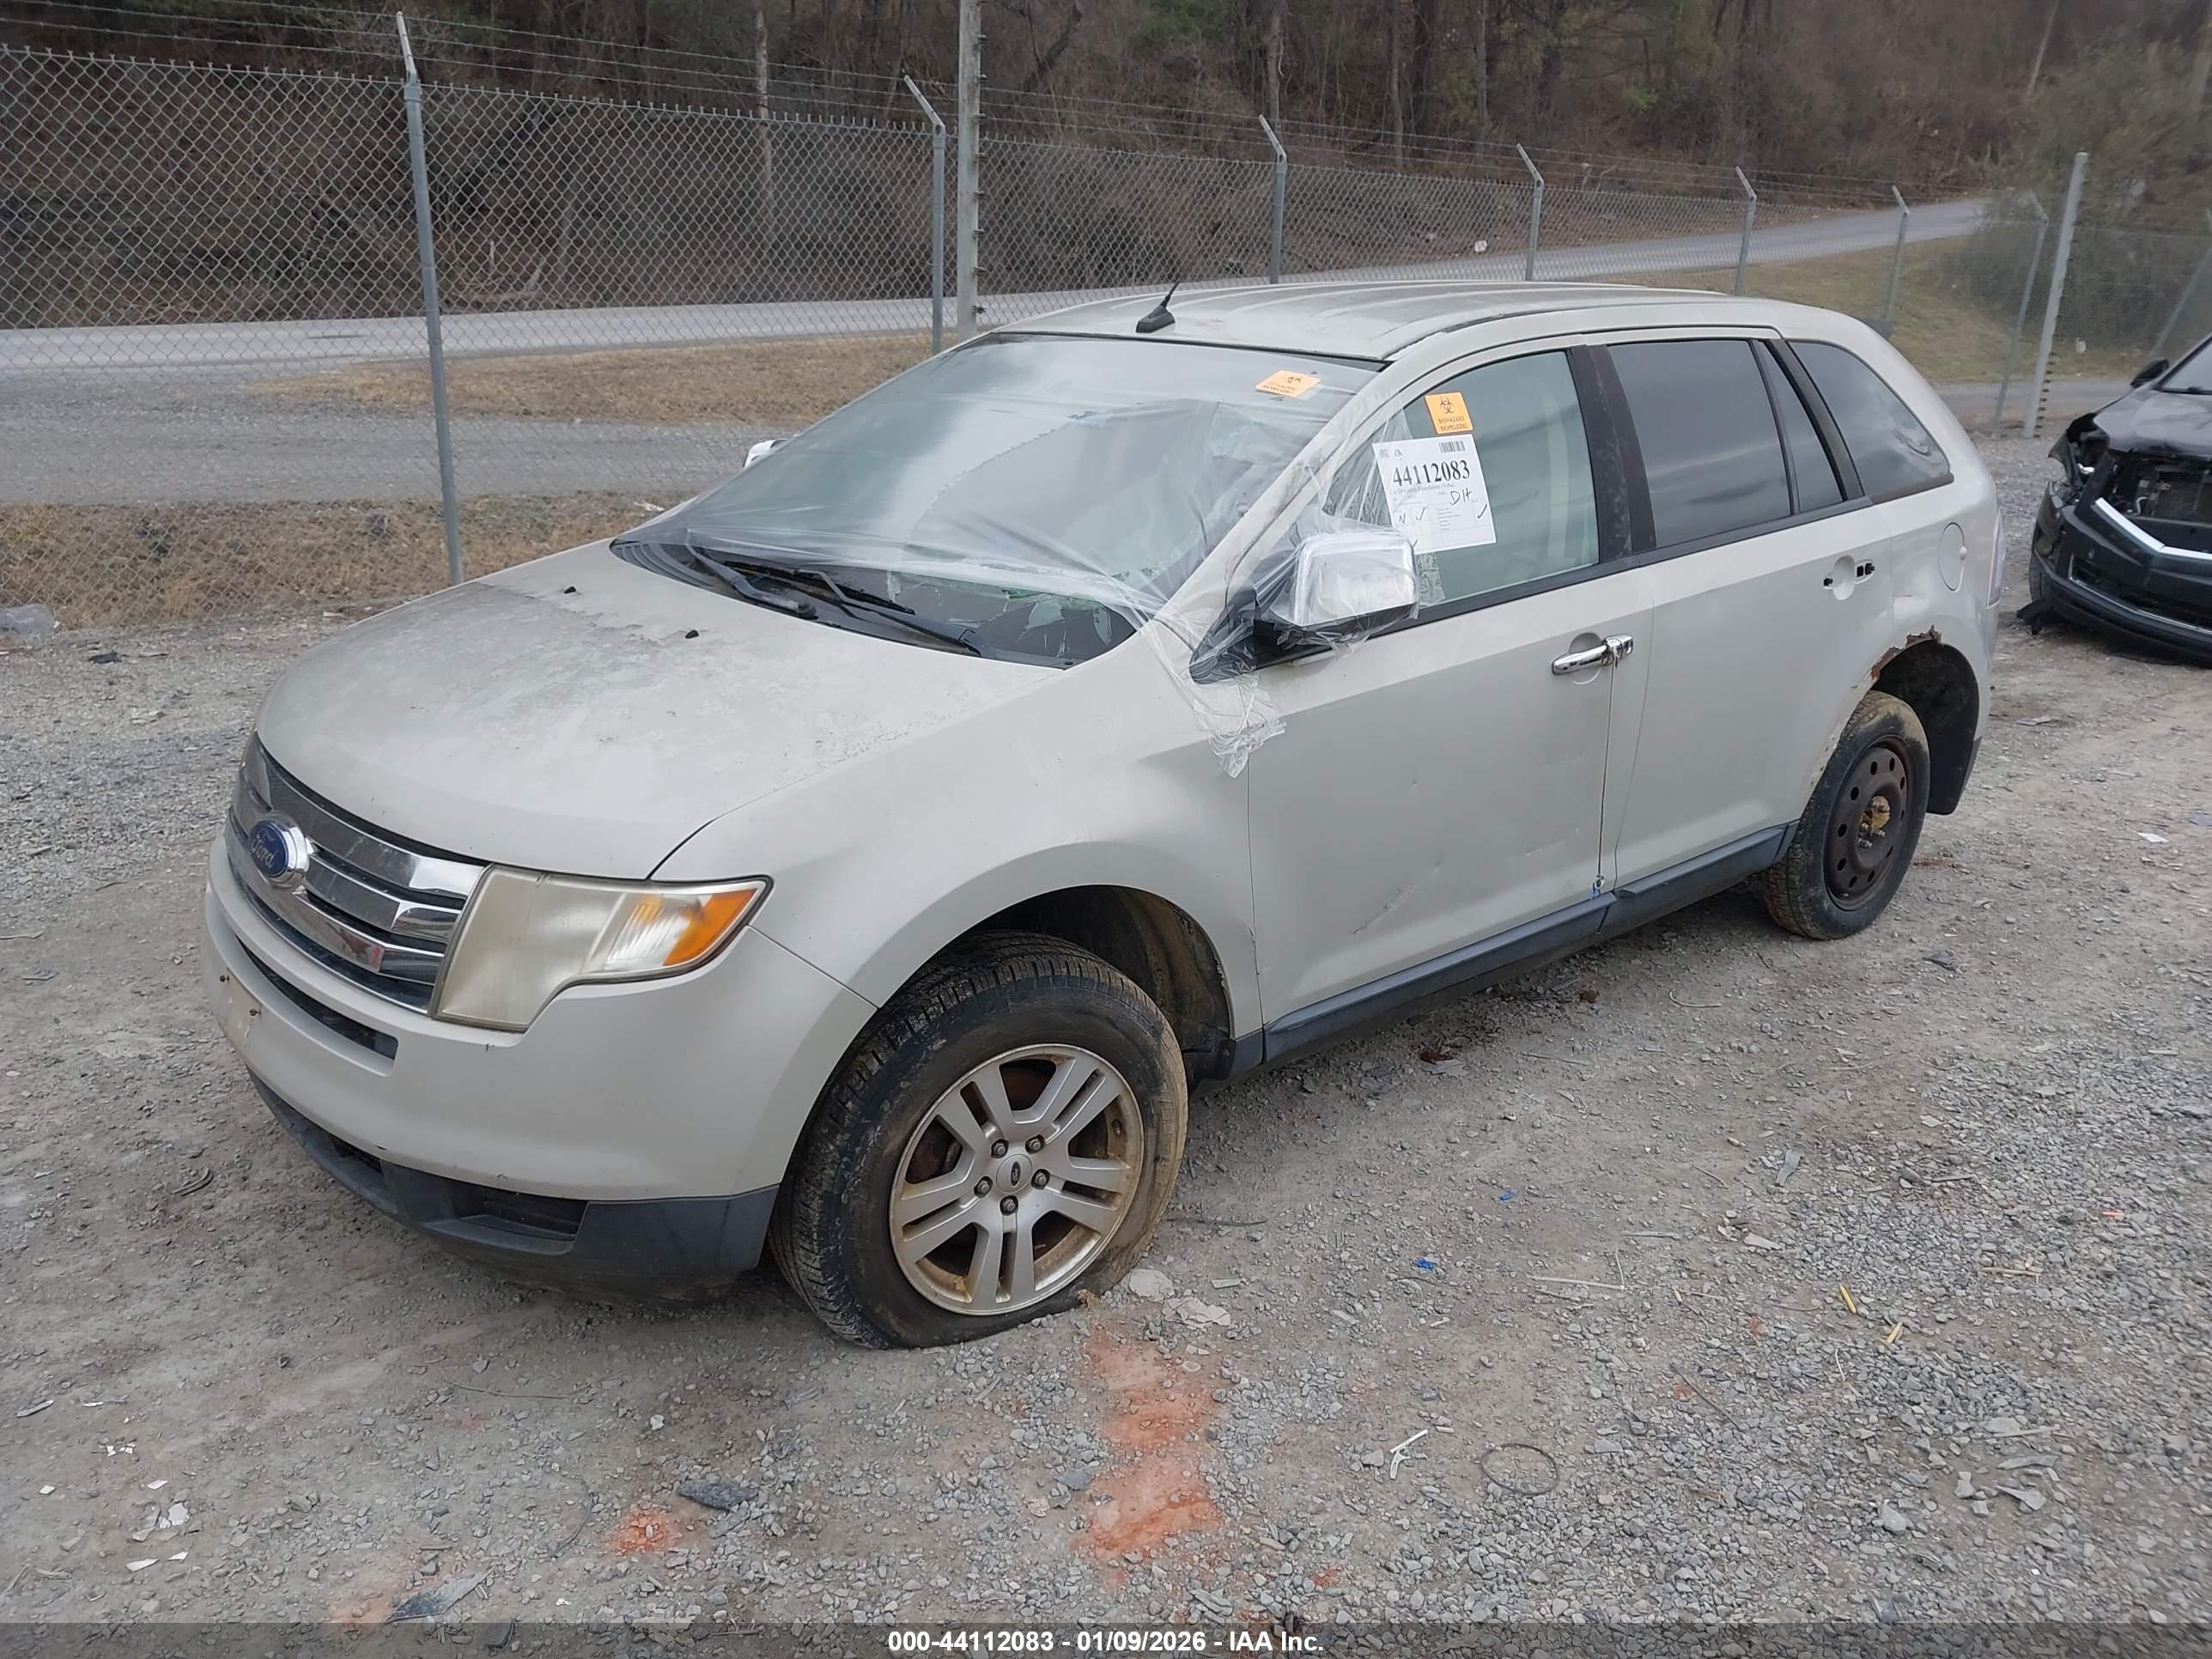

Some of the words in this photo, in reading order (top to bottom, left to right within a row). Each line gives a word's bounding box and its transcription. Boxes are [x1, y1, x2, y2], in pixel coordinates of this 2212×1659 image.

[1393, 459, 1470, 487] 44112083
[1449, 488, 1472, 505] DH
[251, 828, 277, 869] Ford
